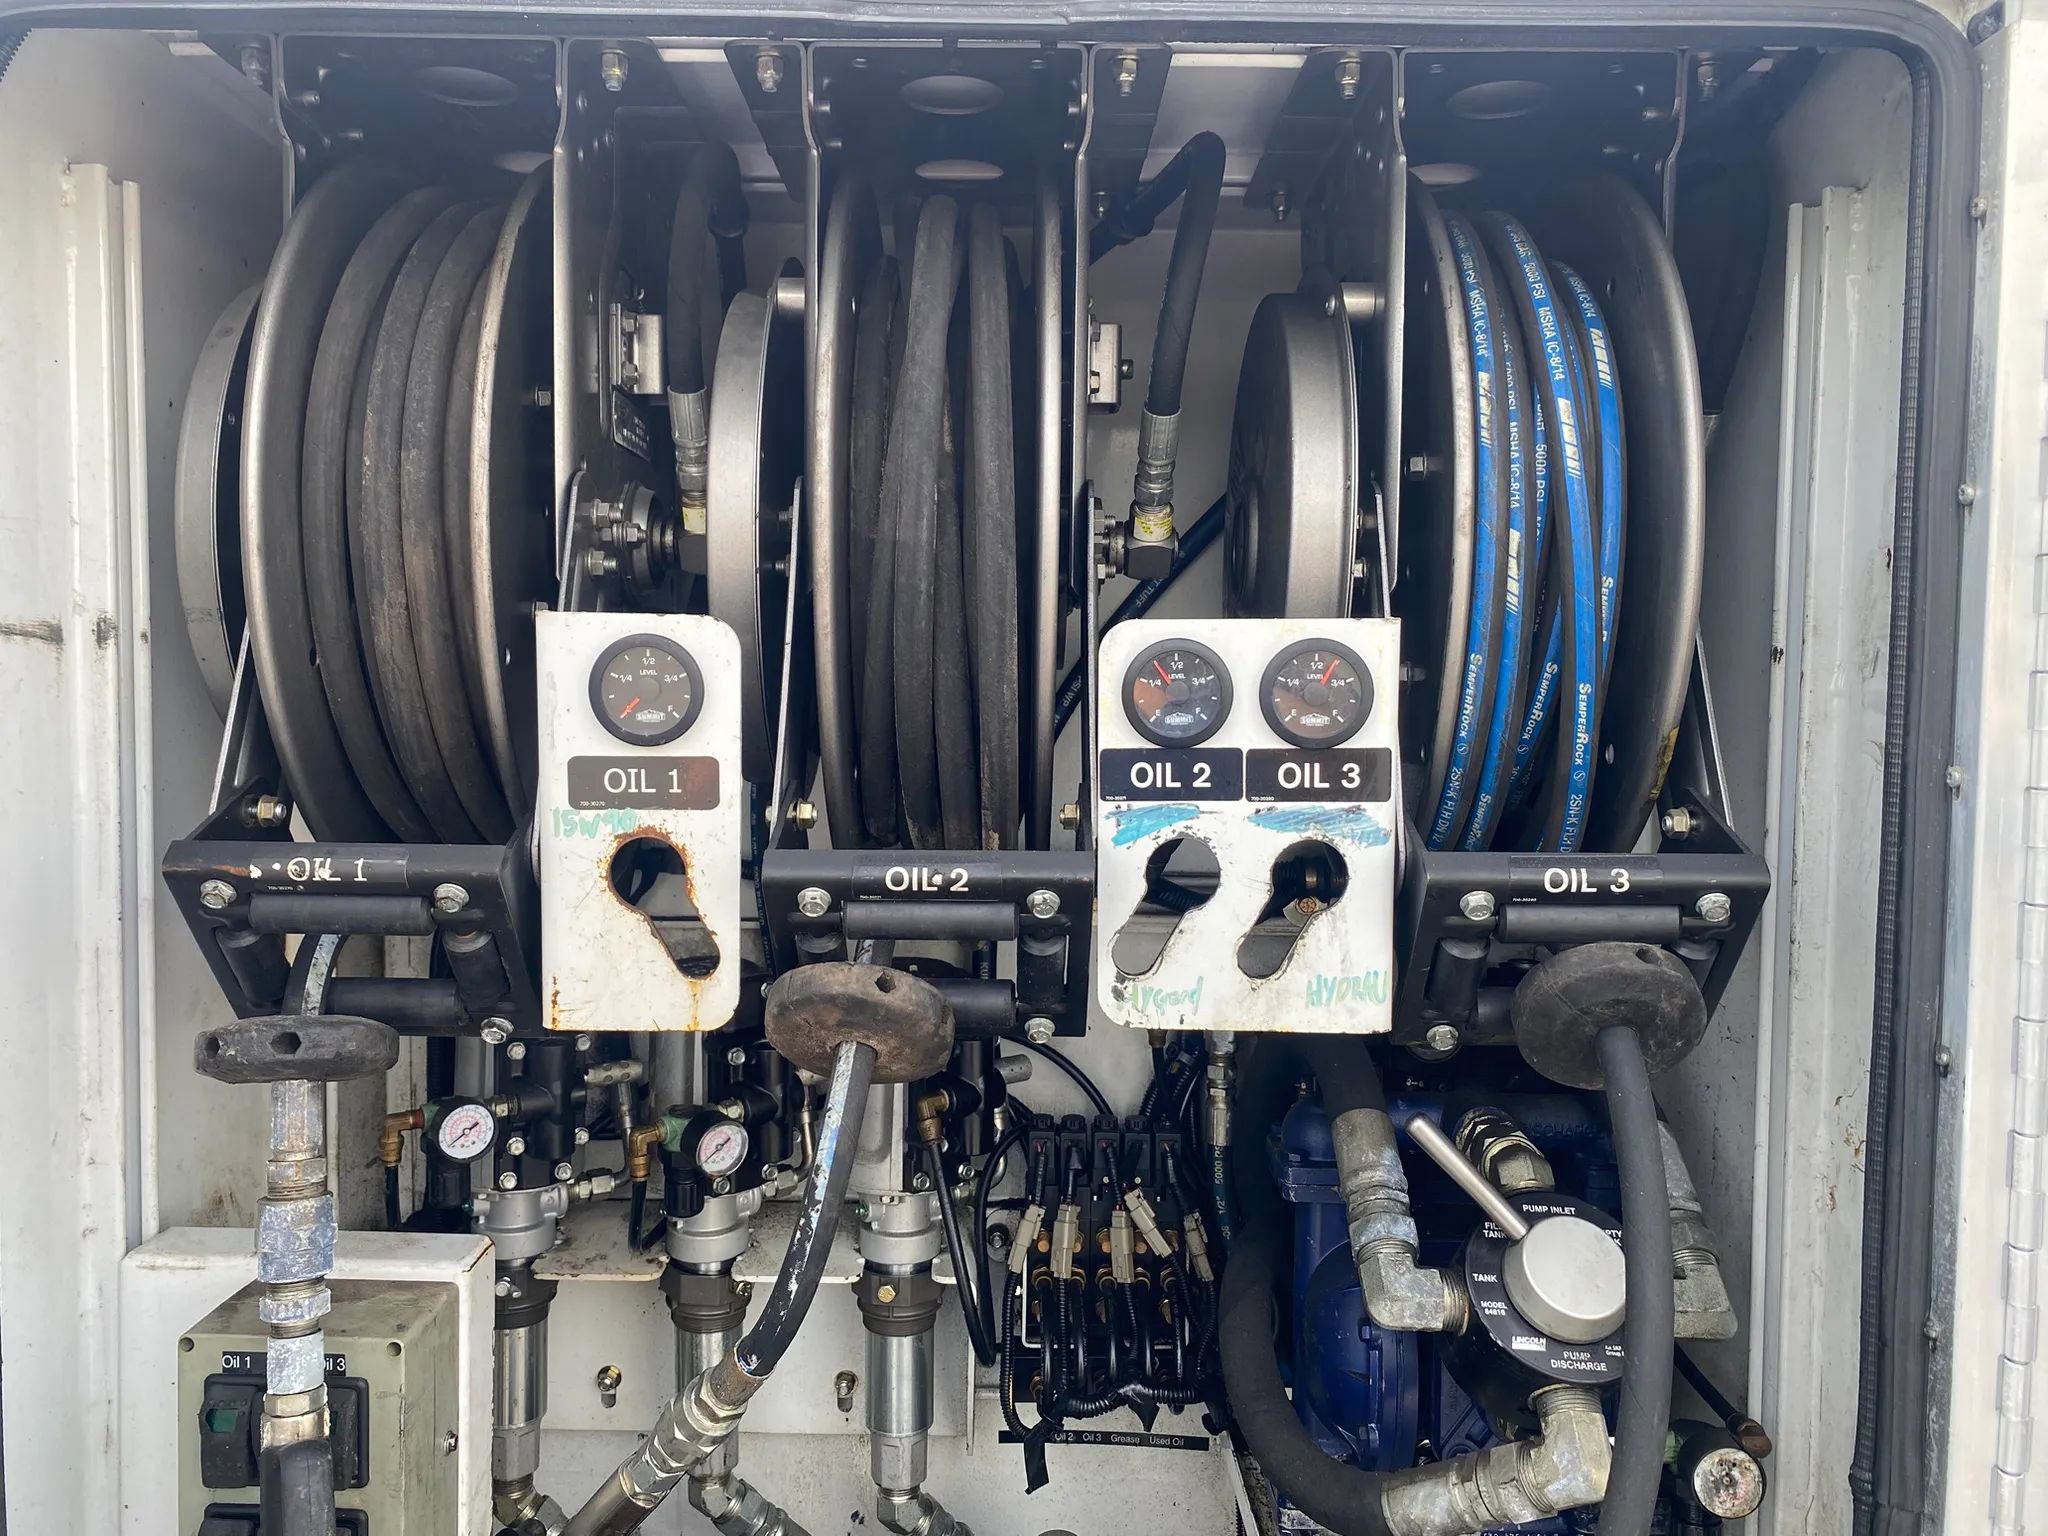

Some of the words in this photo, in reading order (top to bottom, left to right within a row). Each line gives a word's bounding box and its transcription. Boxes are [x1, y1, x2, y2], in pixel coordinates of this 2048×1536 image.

[1524, 262, 1540, 282] 5000
[1532, 283, 1547, 299] PSI
[1469, 289, 1485, 319] MSHA
[1538, 306, 1556, 340] MSHA
[1474, 321, 1489, 358] IC-8/14
[1547, 341, 1566, 381] IC-8/14
[1510, 422, 1519, 461] MSHA
[1535, 443, 1548, 477] 5000
[642, 657, 656, 666] 1/2
[1171, 661, 1184, 671] 1/2
[1310, 661, 1323, 671] 1/2
[620, 674, 633, 683] 1/4
[664, 674, 678, 683] 3/4
[1149, 678, 1161, 688] 1/4
[1192, 677, 1206, 686] 3/4
[1287, 678, 1299, 688] 1/4
[1331, 678, 1345, 687] 3/4
[668, 705, 673, 713] F
[604, 768, 656, 793] OIL
[668, 769, 682, 793] 1
[1130, 762, 1181, 788] OIL
[1193, 762, 1212, 788] 2
[1278, 762, 1330, 789] OIL
[1341, 762, 1361, 789] 3
[1567, 794, 1583, 825] 2SN-K
[287, 857, 341, 881] OIL
[354, 858, 368, 881] 1
[885, 866, 938, 892] OIL
[950, 867, 969, 892] 2
[1543, 867, 1598, 893] OIL
[1610, 867, 1631, 893] 3
[1214, 1146, 1224, 1158] PS
[1214, 1160, 1224, 1185] 5000
[1522, 1204, 1549, 1213] PUMP
[1550, 1206, 1577, 1216] INLET
[1484, 1221, 1501, 1230] FIL
[1482, 1229, 1508, 1239] TANK
[1604, 1229, 1622, 1238] PTY
[1472, 1273, 1498, 1283] TANK
[1480, 1300, 1508, 1309] MODEL
[1511, 1335, 1547, 1345] LINCOLN
[1563, 1351, 1591, 1361] PUMP
[222, 1355, 242, 1369] Oil
[244, 1356, 251, 1370] 1
[337, 1358, 346, 1370] 3
[1550, 1359, 1608, 1372] DISCHARGE
[1054, 1431, 1067, 1441] Oil
[1067, 1433, 1074, 1441] 2
[1082, 1433, 1095, 1442] Oil
[1096, 1434, 1102, 1442] 3
[1110, 1434, 1140, 1444] Grease
[1149, 1436, 1171, 1446] Used
